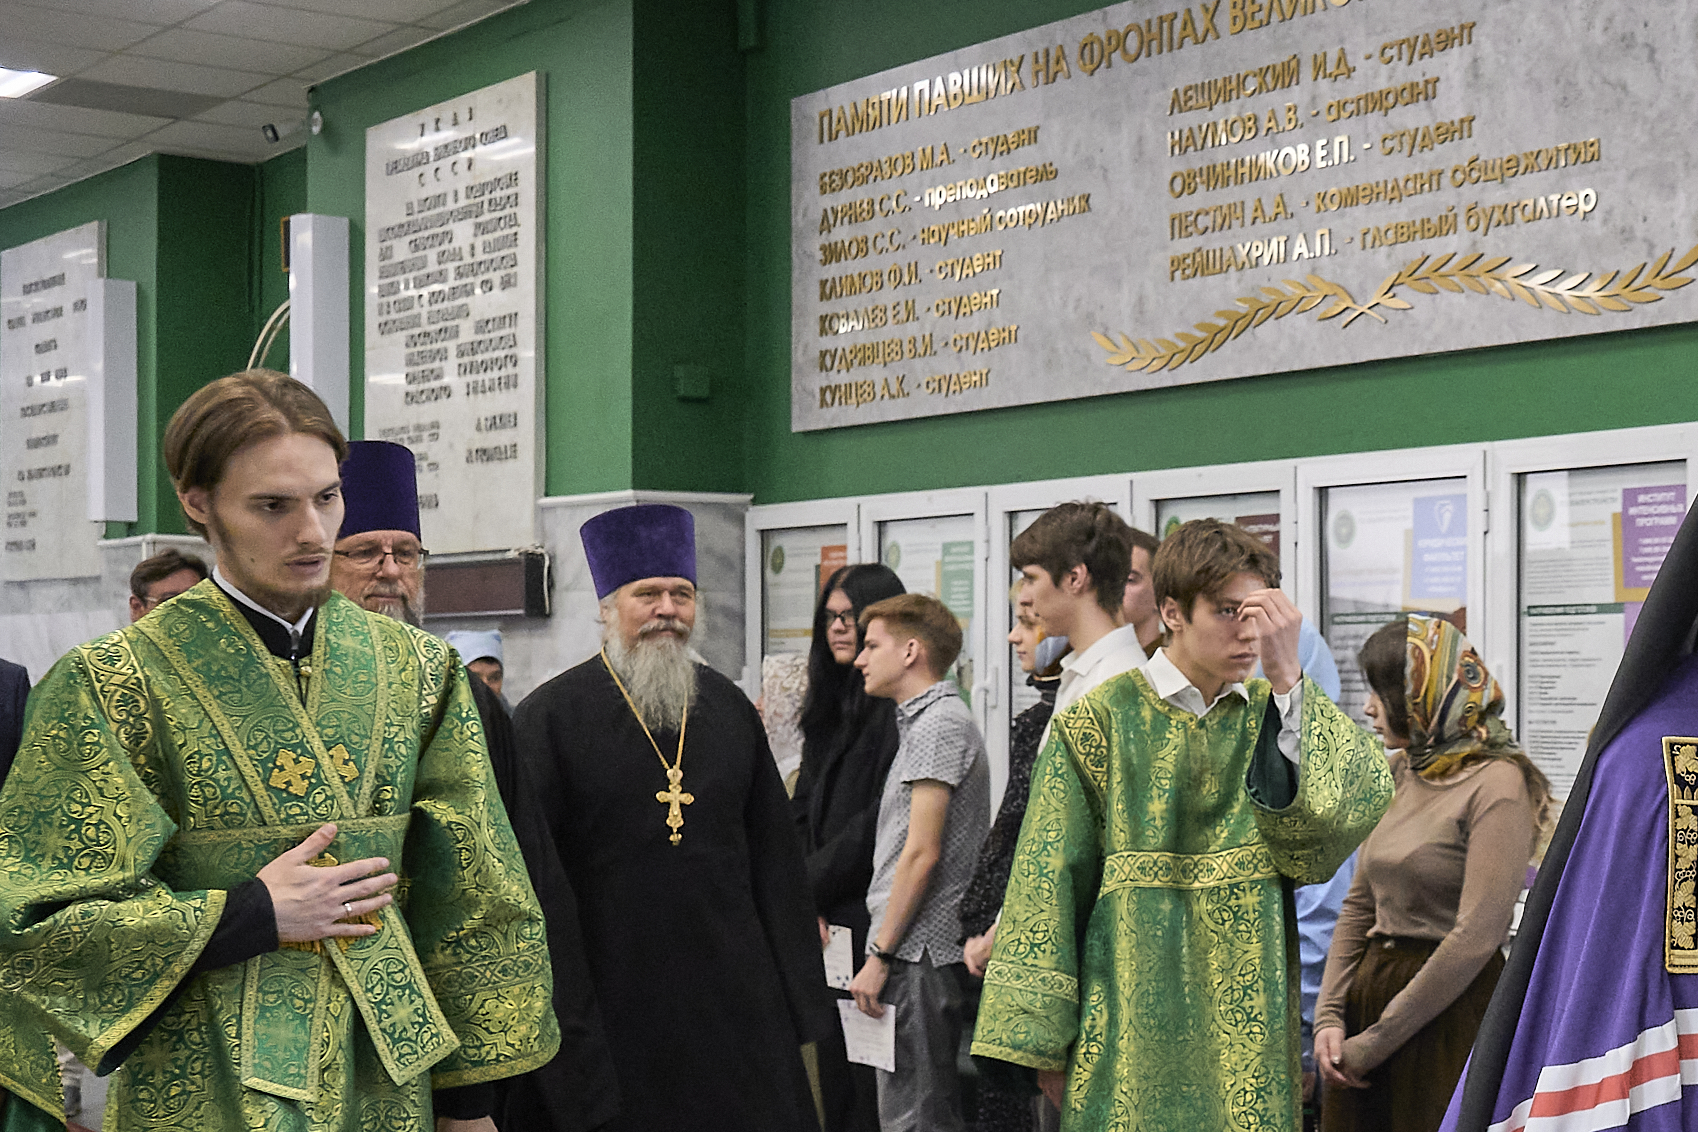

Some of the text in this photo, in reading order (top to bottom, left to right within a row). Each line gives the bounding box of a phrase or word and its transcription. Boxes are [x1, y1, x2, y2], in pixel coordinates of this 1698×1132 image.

[818, 86, 909, 144] ПАМЯТИ
[913, 54, 1025, 118] ПАВШИХ
[1031, 44, 1071, 88] НА
[1078, 0, 1220, 75] ФРОНТАХ
[1167, 54, 1300, 116] ЛЕЩИНСКИЙ
[1311, 47, 1356, 82] И.Д.
[1378, 19, 1478, 65] студент
[1167, 113, 1258, 157] НАУМОВ
[1263, 102, 1304, 136] А.В.
[1325, 76, 1440, 123] аспирант
[819, 151, 915, 195] БЕЗОБРАЗОВ
[917, 142, 955, 172] М.А.
[969, 125, 1041, 160] студент
[1169, 143, 1311, 199] ОВЧИННИКОВ
[1315, 134, 1356, 169] Е.П.
[1379, 114, 1476, 157] студент
[1169, 201, 1245, 241] ПЕСТИЧ
[1251, 192, 1294, 226] А.А.
[1315, 168, 1445, 213] комендант
[1451, 137, 1601, 189] общежития
[819, 197, 875, 236] ДУРНЕВ
[878, 189, 912, 218] С.С.
[924, 161, 1058, 210] преподаватель
[819, 234, 869, 266] ЗИЛОВ
[871, 228, 906, 255] С.С.
[919, 208, 993, 247] научный
[995, 193, 1092, 230] сотрудник
[1169, 234, 1289, 282] РЕЙШАХРИТ
[1292, 227, 1338, 261] А.П.
[1360, 205, 1458, 251] главный
[1465, 187, 1598, 237] бухгалтер
[819, 270, 884, 302] КЛИМОВ
[887, 261, 922, 290] Ф.И.
[936, 249, 1004, 282] студент
[819, 303, 887, 337] КОВАЛЕВ
[891, 299, 919, 326] Е.И.
[934, 288, 1001, 320] студент
[819, 337, 903, 374] КУДРЯВЦЕВ
[906, 332, 937, 359] В.И.
[952, 324, 1020, 355] студент
[819, 380, 876, 409] КУНЦЕВ
[880, 373, 910, 401] А.К.
[924, 367, 991, 398] студент
